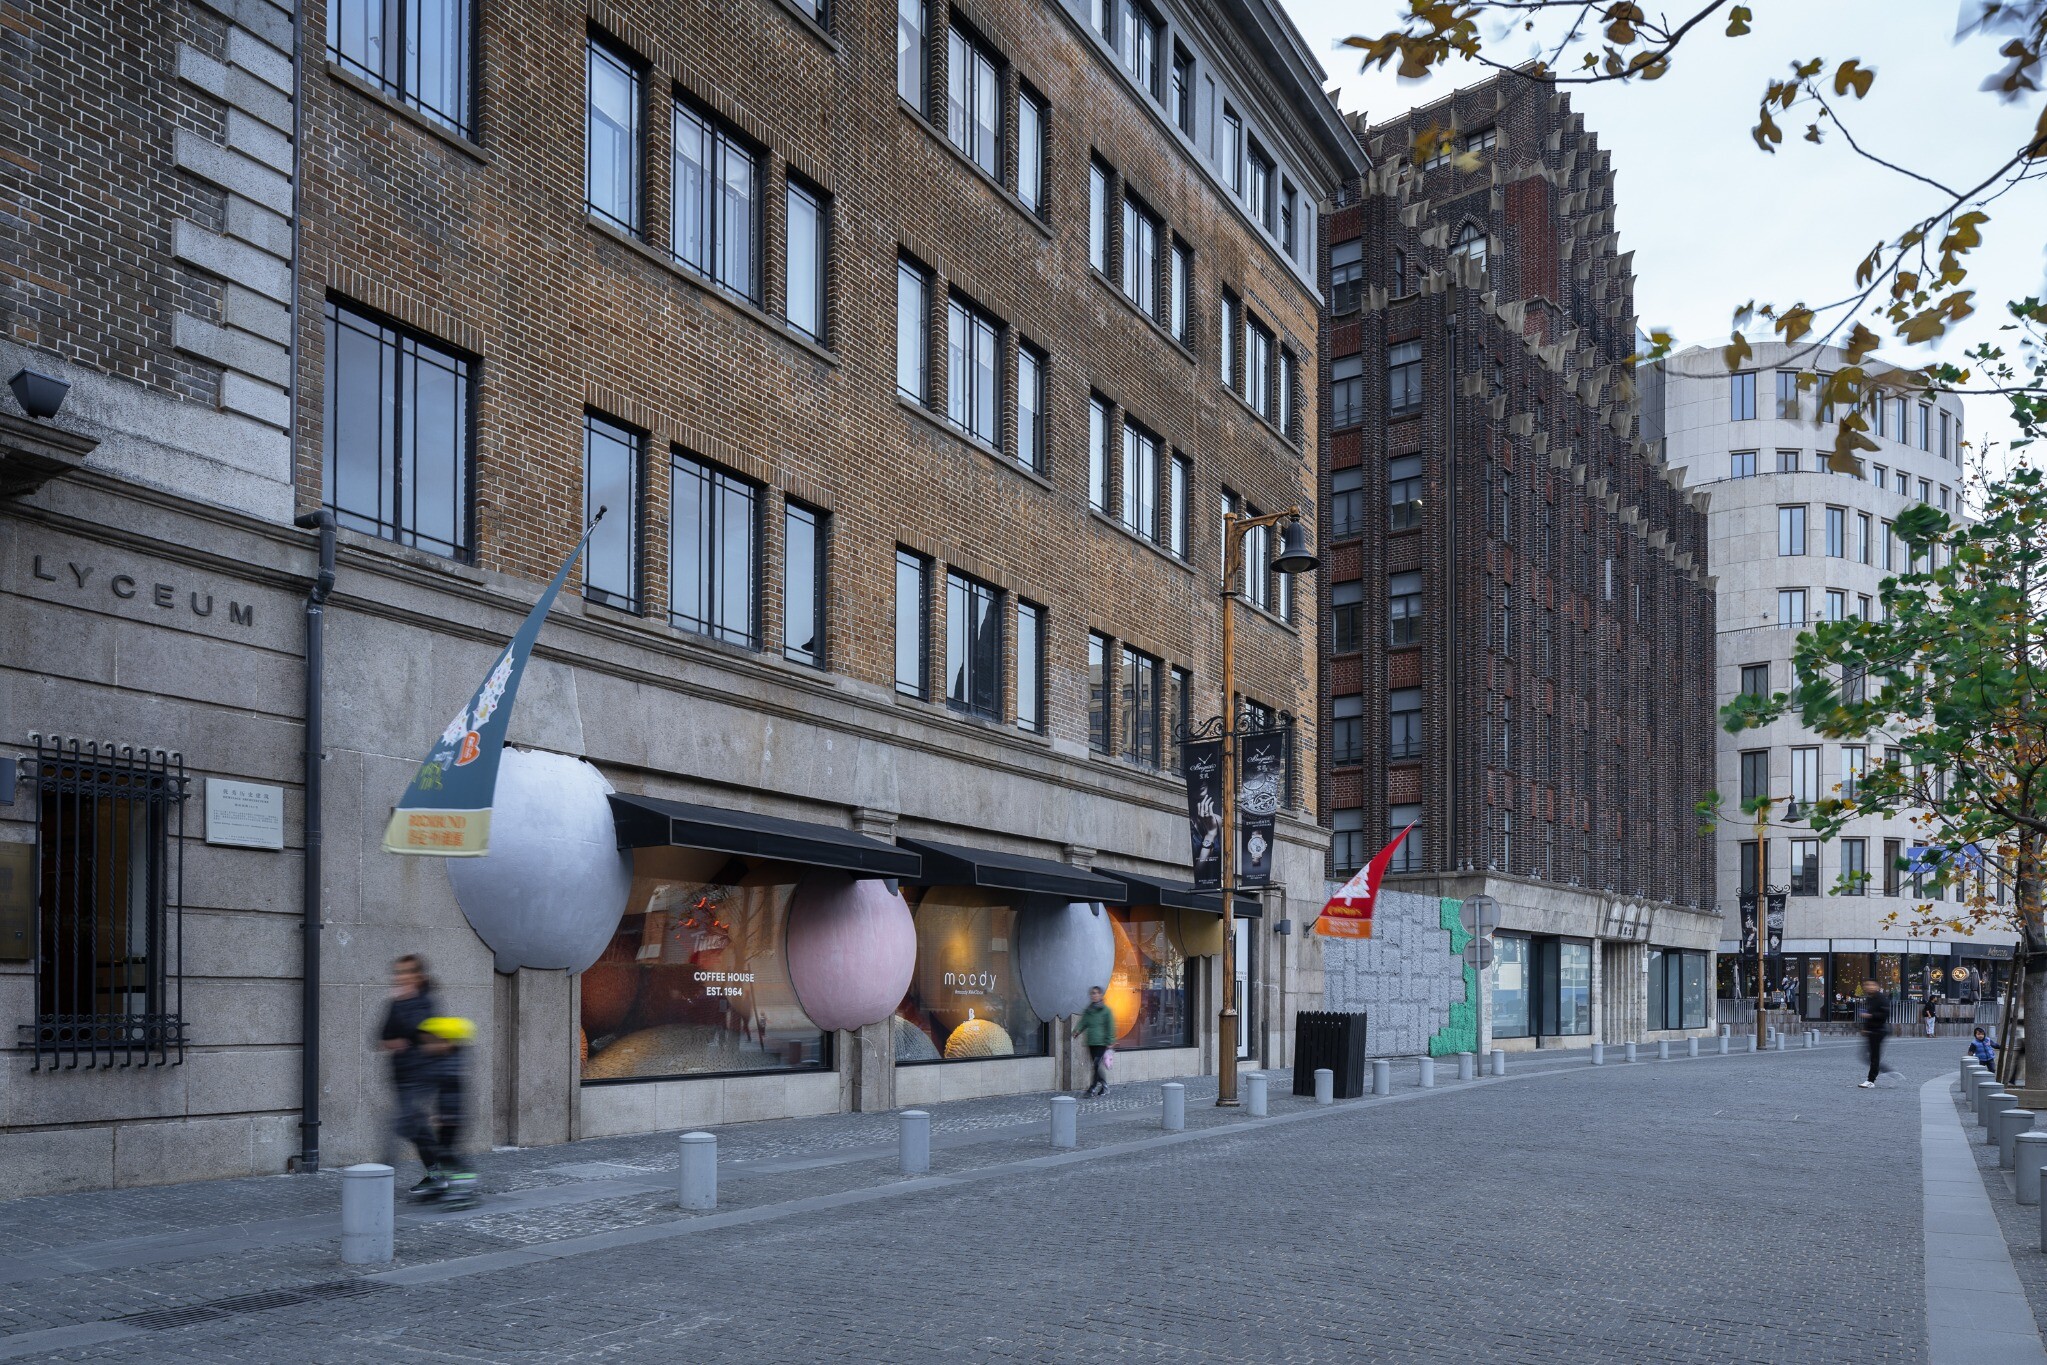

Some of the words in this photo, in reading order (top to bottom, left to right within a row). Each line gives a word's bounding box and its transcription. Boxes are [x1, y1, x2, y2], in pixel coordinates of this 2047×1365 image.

[34, 554, 254, 627] LYCEUM
[694, 971, 726, 982] COFFEE
[727, 972, 755, 983] HOUSE
[944, 970, 997, 990] moody
[706, 986, 723, 997] EST.
[724, 987, 743, 997] 1964
